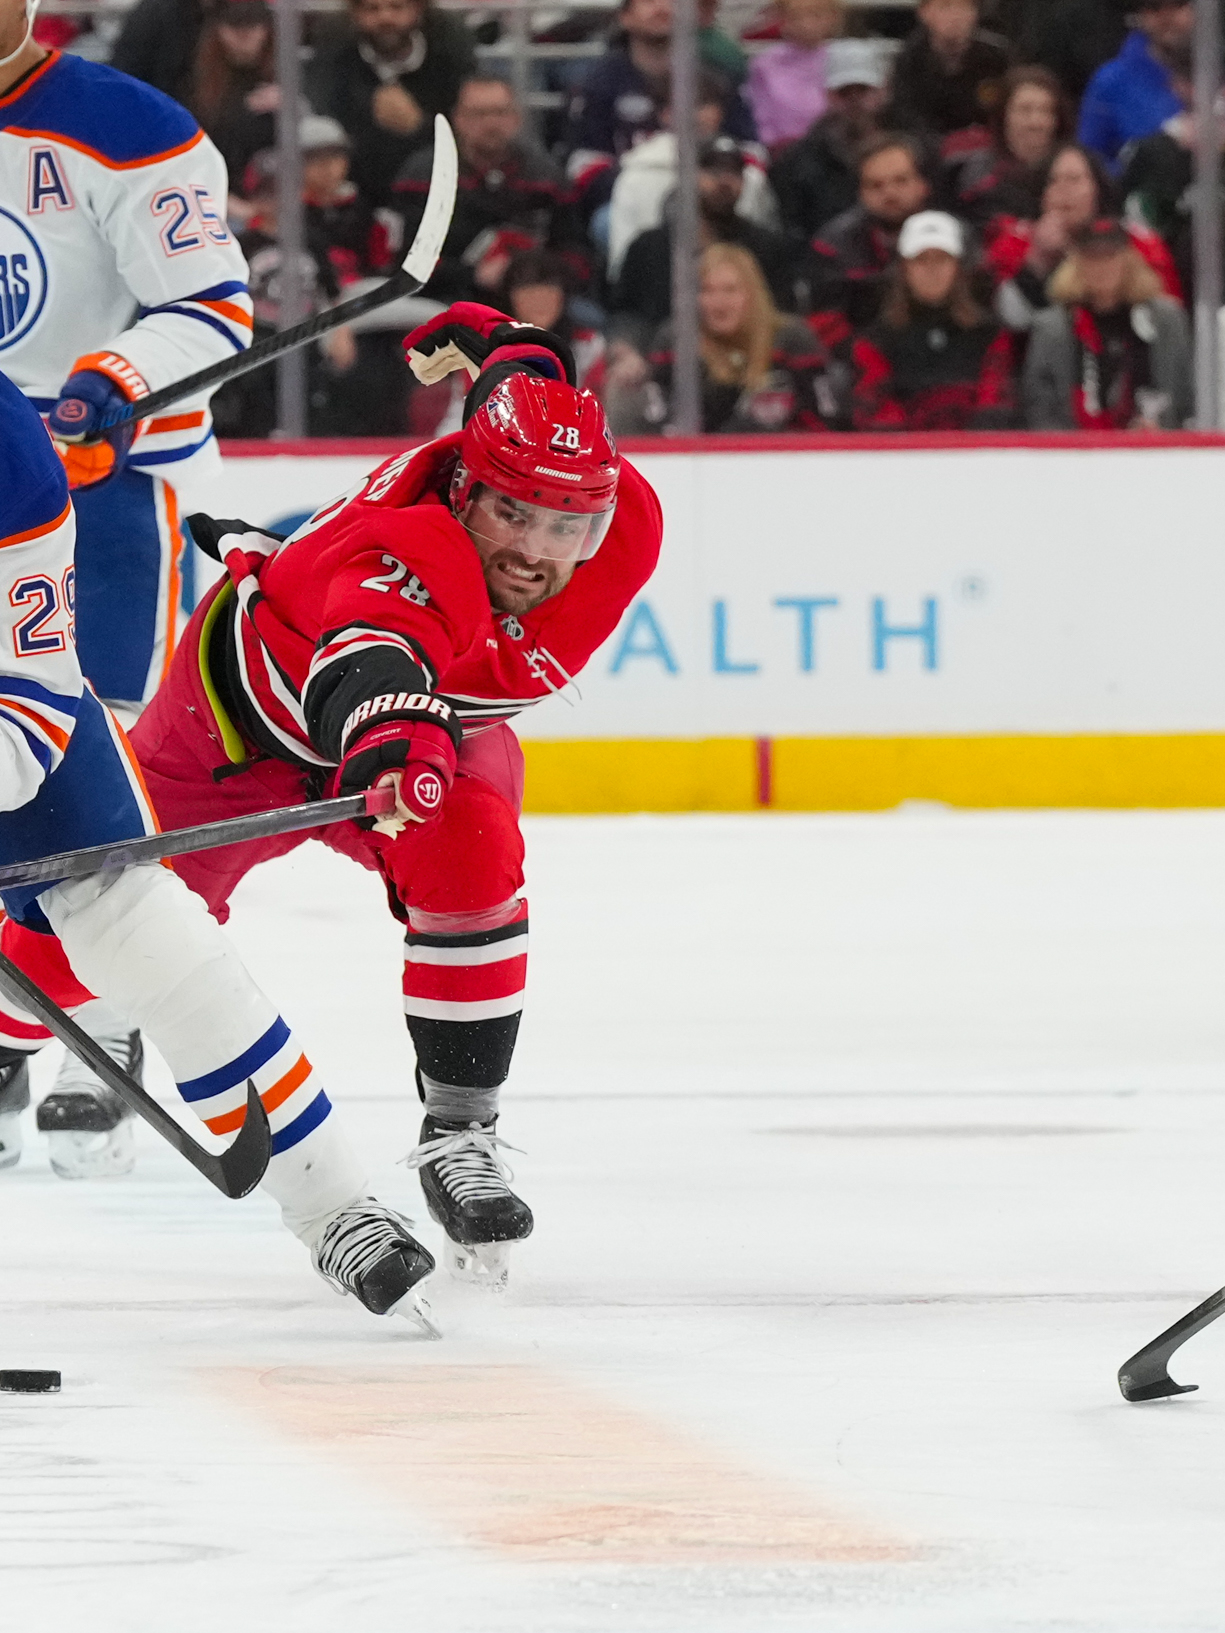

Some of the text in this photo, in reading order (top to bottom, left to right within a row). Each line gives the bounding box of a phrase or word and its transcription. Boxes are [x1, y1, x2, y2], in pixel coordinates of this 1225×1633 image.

[28, 145, 75, 215] A
[150, 184, 232, 257] 25
[550, 423, 581, 449] 28
[534, 465, 583, 482] WARRIOR
[359, 553, 432, 608] 28
[341, 692, 453, 760] ARRIOR
[370, 727, 402, 741] COVERT
